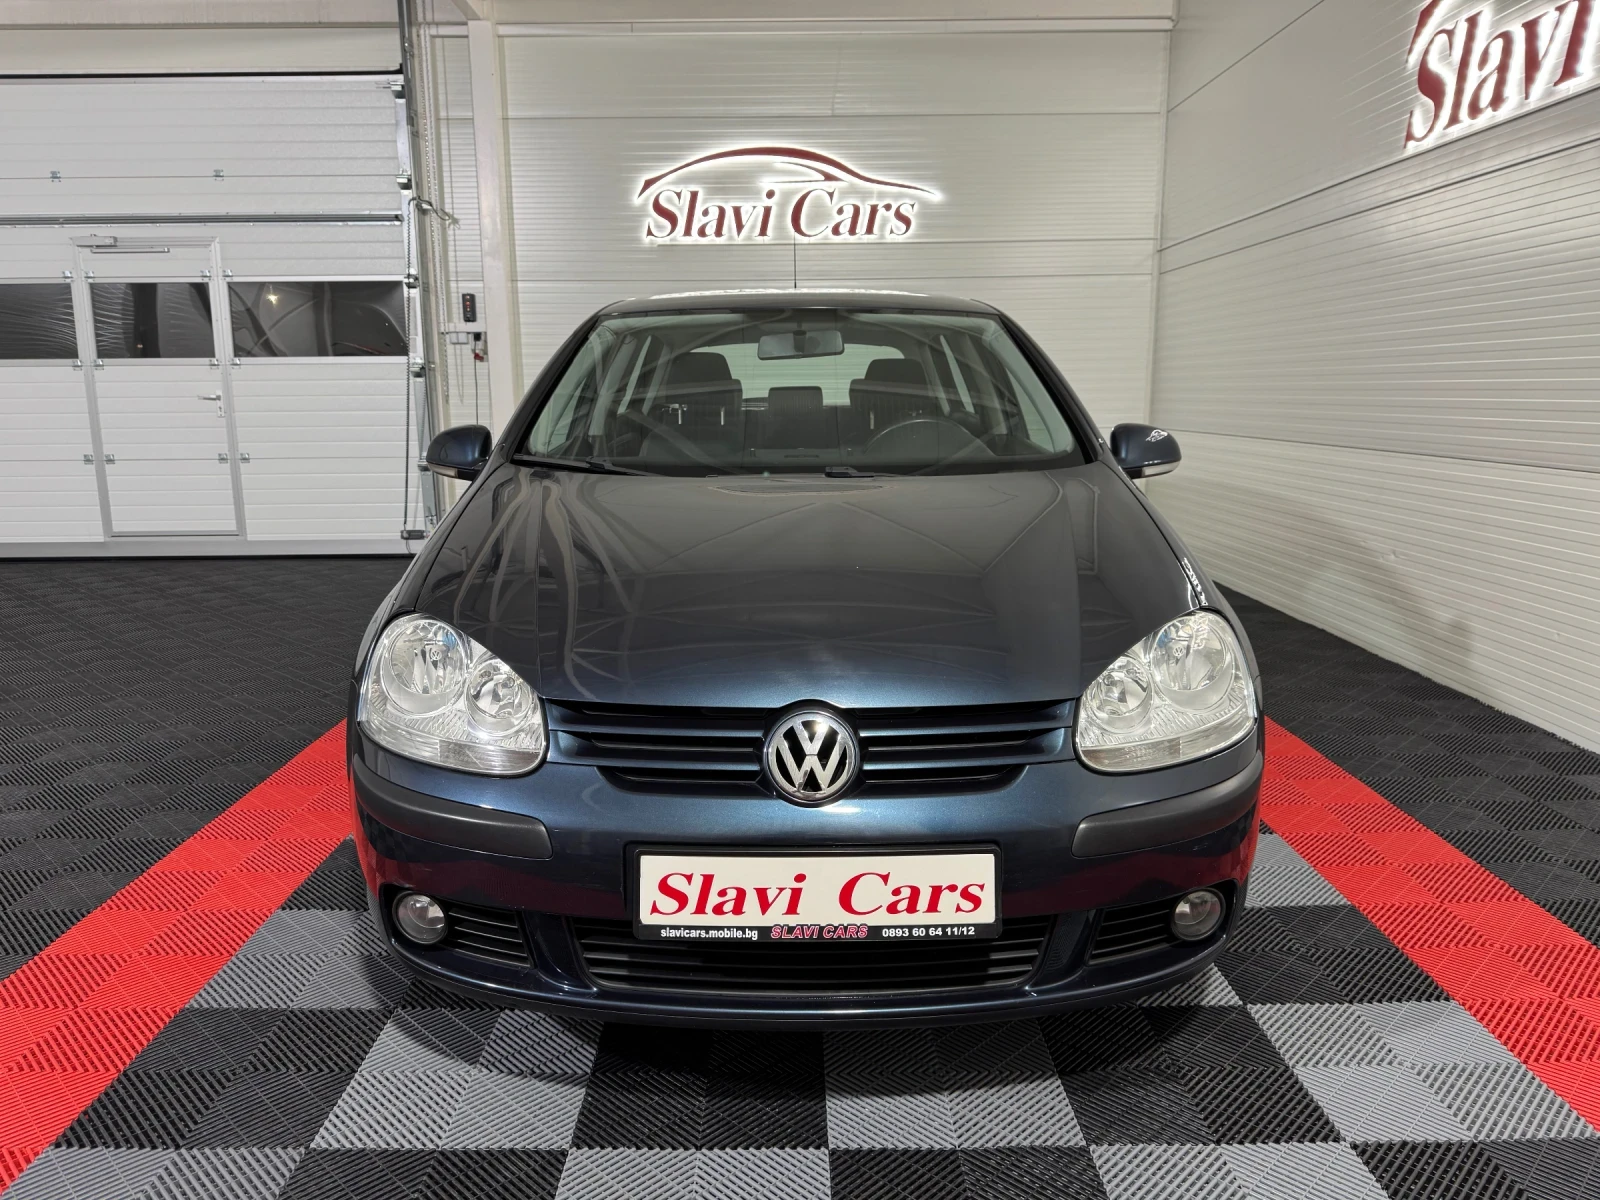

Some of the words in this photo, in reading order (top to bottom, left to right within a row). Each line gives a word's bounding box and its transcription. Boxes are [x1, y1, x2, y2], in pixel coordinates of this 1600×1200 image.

[1403, 0, 1592, 149] Slavi
[645, 188, 776, 240] Slavi
[789, 188, 917, 239] Cars
[767, 713, 854, 800] VW
[649, 872, 807, 916] Slavi
[838, 871, 986, 916] Cars
[660, 927, 758, 940] slavicars.mobile.bg
[770, 925, 820, 940] SLAVI
[822, 924, 869, 939] CARS
[881, 928, 910, 938] 0893
[911, 928, 926, 938] 60
[928, 927, 943, 938] 64
[945, 926, 976, 937] 11/12
